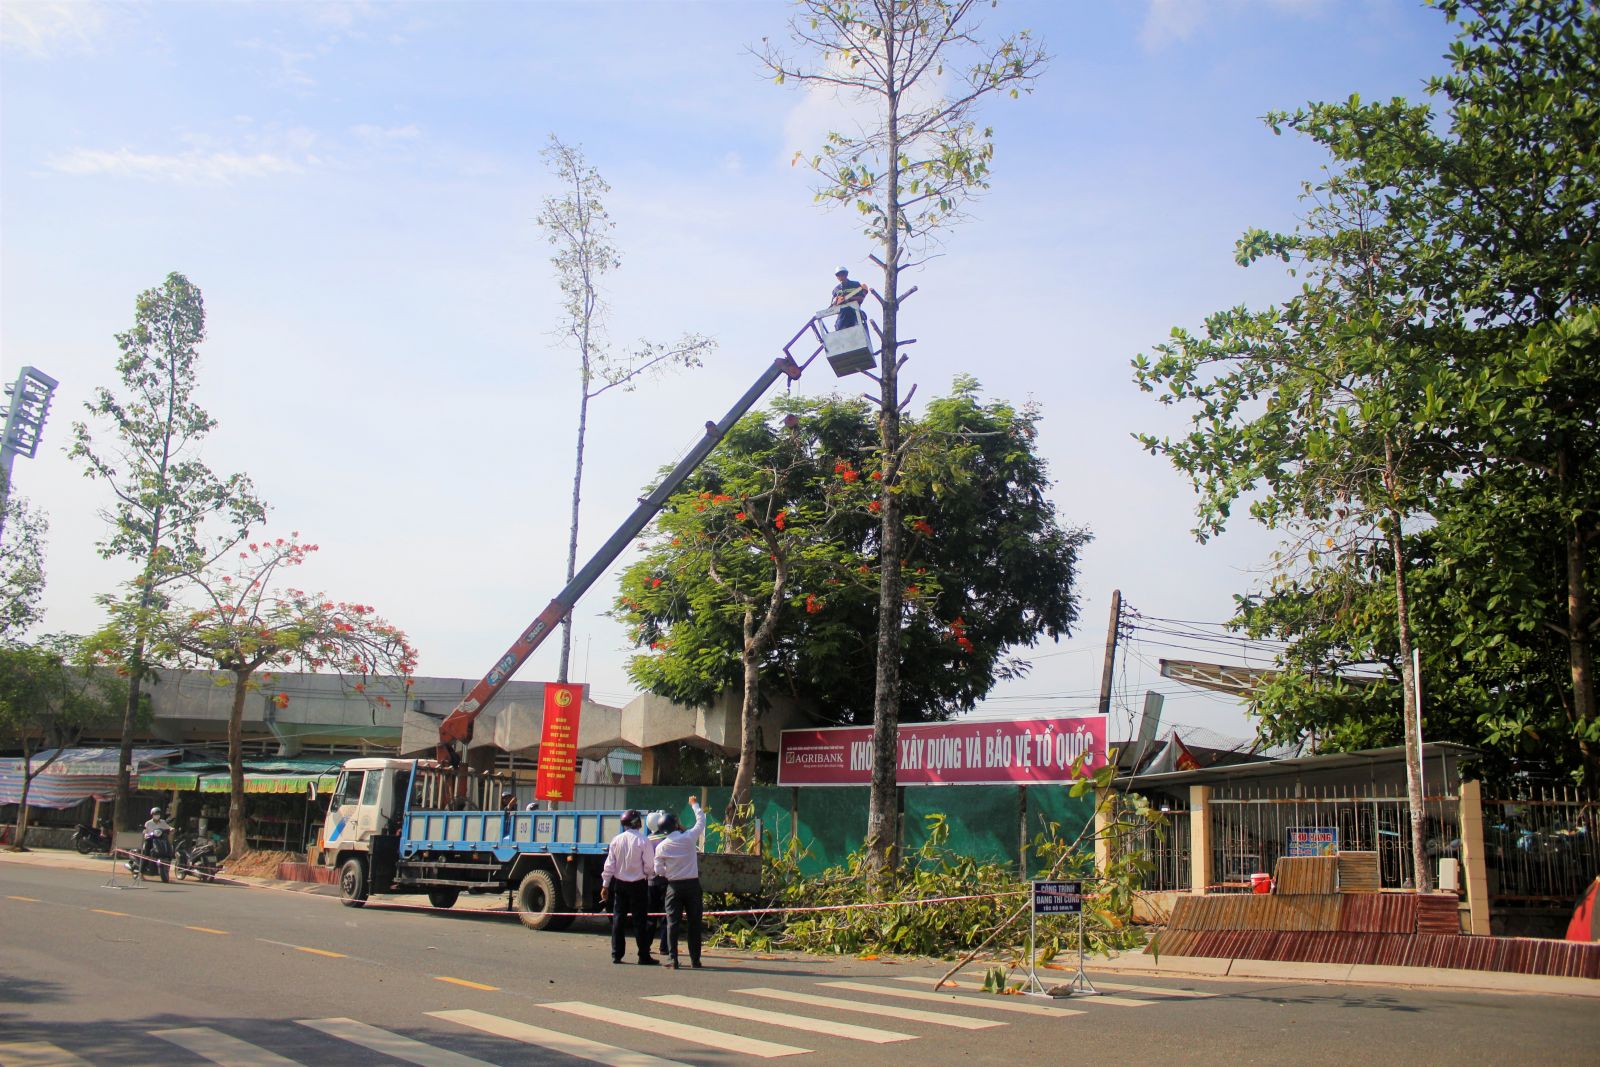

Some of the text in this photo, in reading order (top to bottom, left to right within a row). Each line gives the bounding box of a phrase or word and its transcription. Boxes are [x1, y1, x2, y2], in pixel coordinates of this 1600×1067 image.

[851, 724, 1094, 775] KHỎ XÂY DỰNG VÀ BẢO VỆ TỔ QUỐC
[795, 752, 844, 763] AGRIBANK
[1054, 895, 1063, 904] THI
